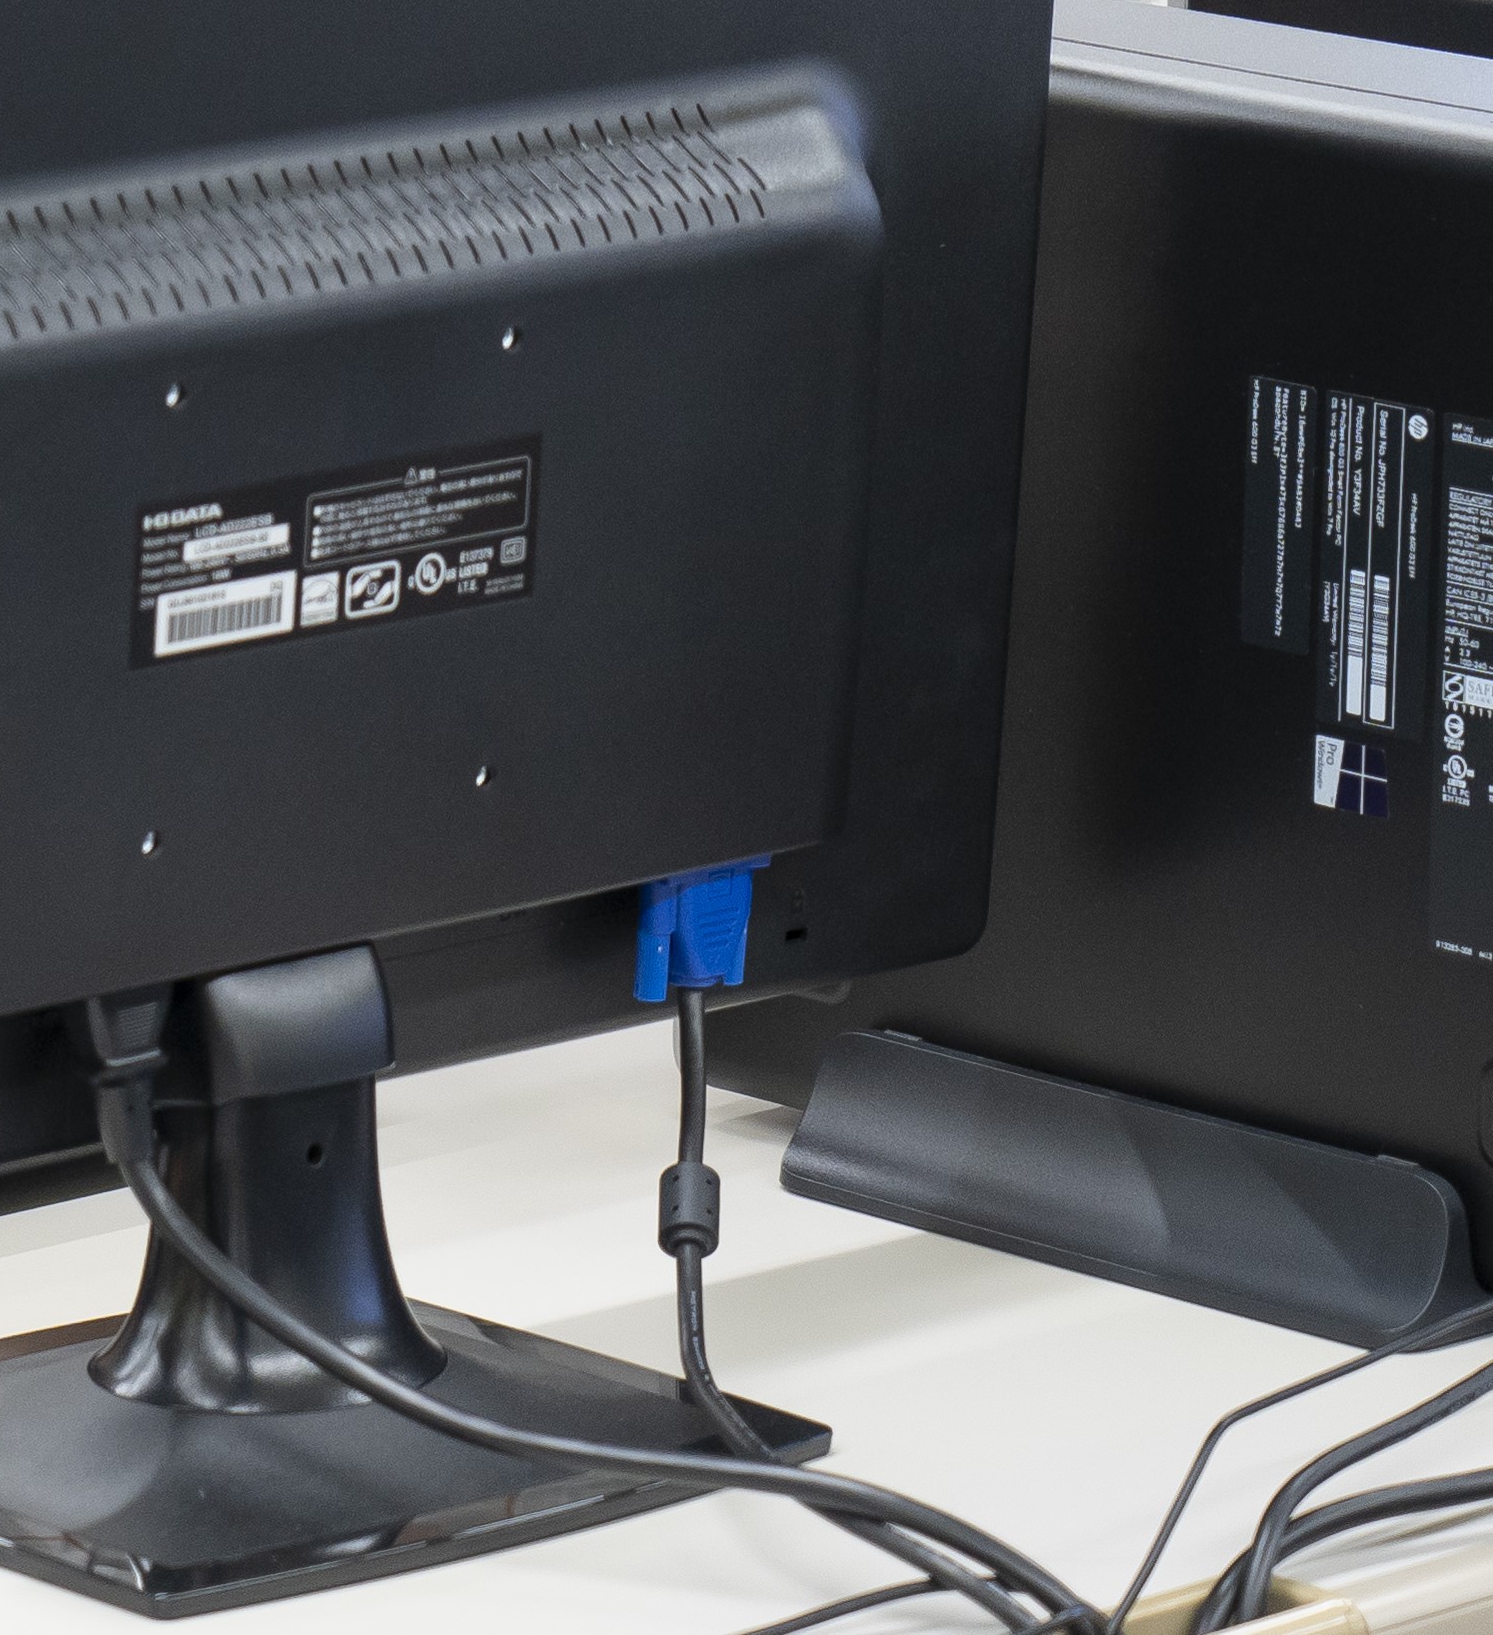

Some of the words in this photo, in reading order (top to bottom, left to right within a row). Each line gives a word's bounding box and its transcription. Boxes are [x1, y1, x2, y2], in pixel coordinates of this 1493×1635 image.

[1354, 405, 1364, 443] Product
[1379, 409, 1387, 437] Serial
[1409, 417, 1428, 438] hp
[1317, 740, 1326, 787] Windows
[1326, 742, 1338, 766] Pro
